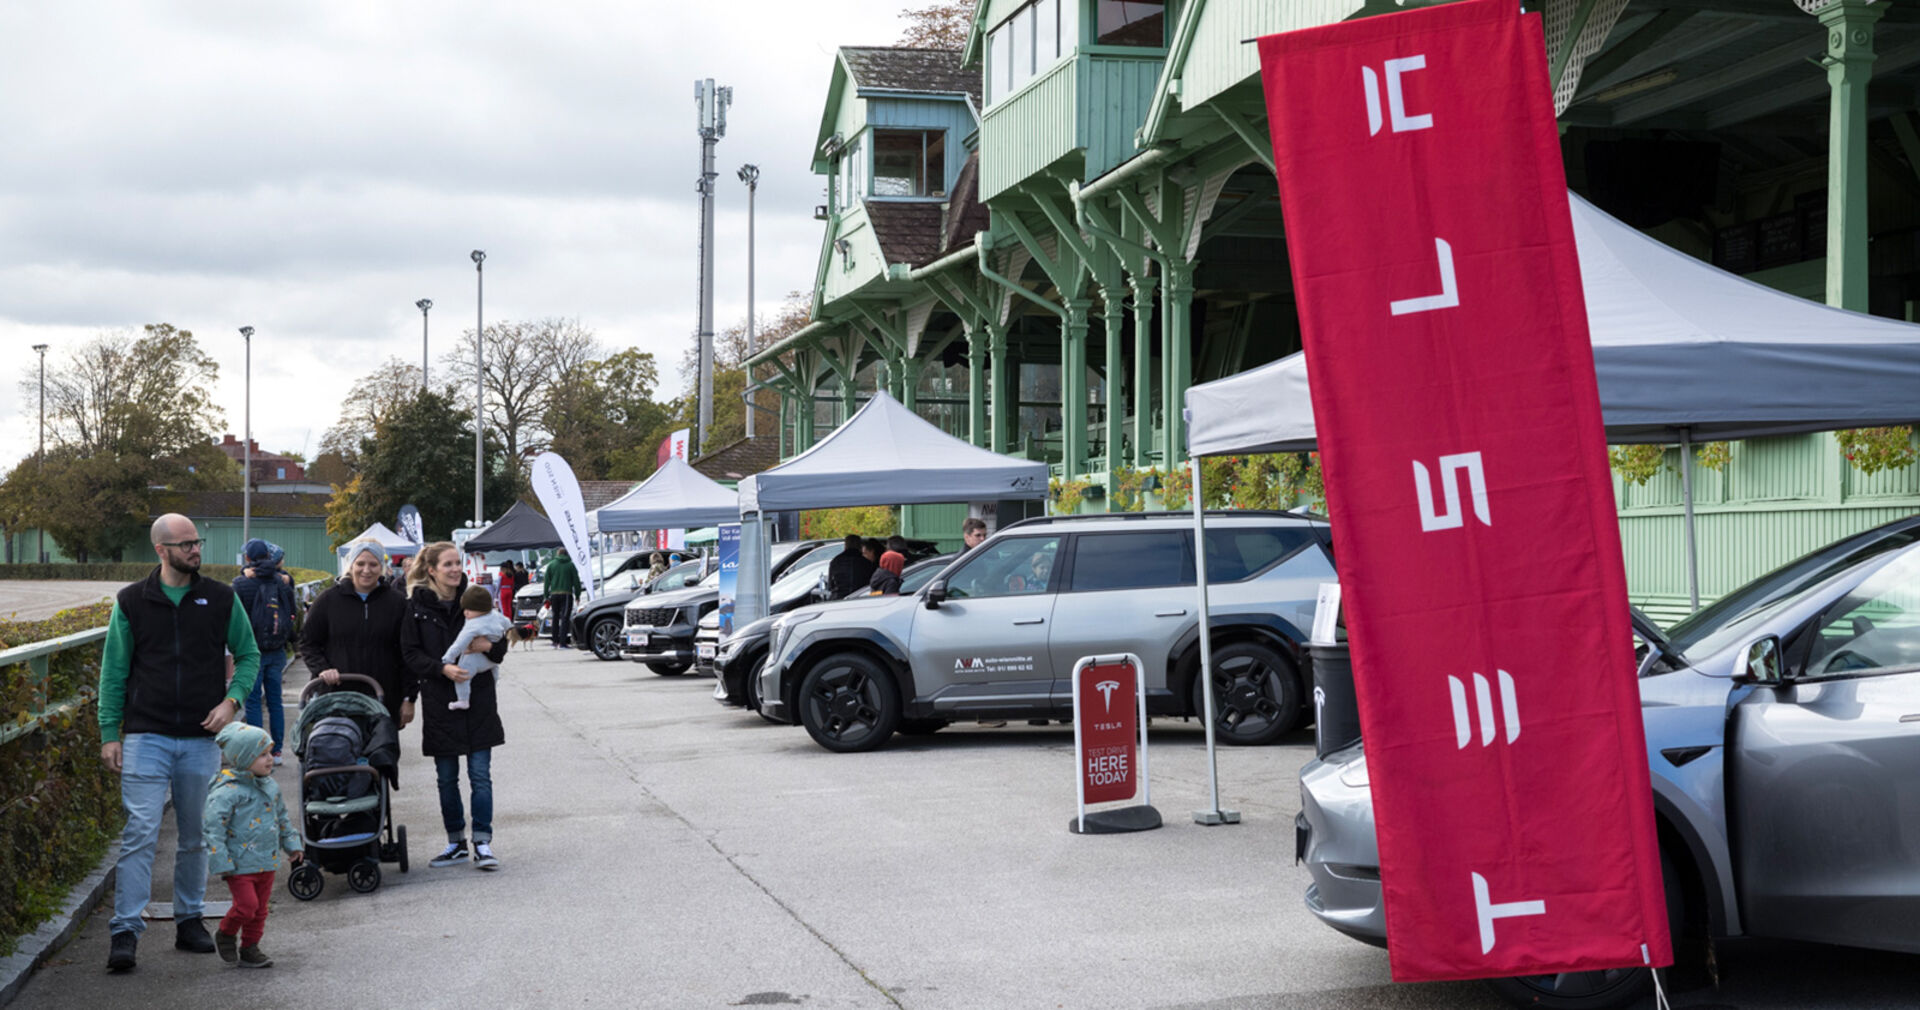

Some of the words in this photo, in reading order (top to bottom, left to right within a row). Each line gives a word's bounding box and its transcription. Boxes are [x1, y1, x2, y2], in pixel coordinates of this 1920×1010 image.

[981, 502, 998, 516] AW
[1362, 54, 1546, 956] TESLA
[954, 657, 985, 669] AWM
[1094, 721, 1123, 731] TESLA
[1088, 747, 1105, 758] TEST
[1106, 745, 1129, 755] DRIVE
[1088, 754, 1129, 774] HERE
[1088, 770, 1129, 787] TODAY
